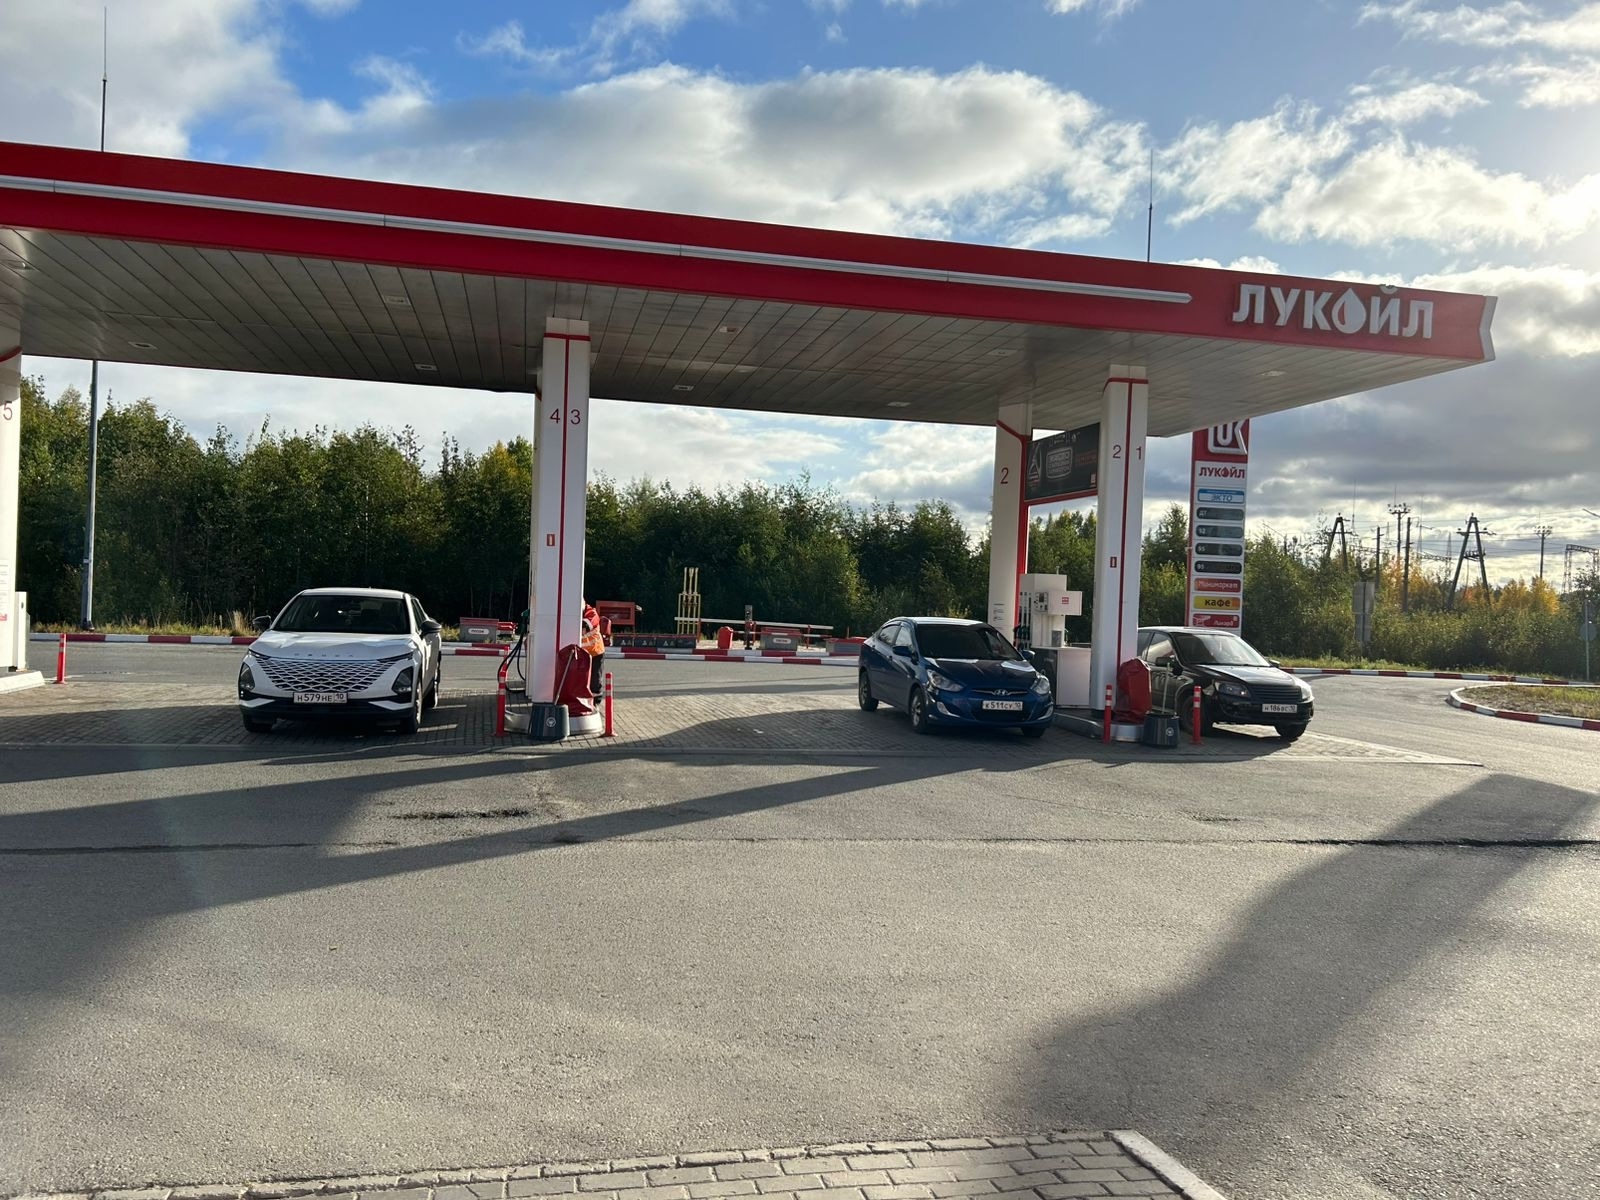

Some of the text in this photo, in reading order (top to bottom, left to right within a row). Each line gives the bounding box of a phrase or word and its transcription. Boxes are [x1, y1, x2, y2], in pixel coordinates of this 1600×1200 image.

[1232, 283, 1435, 339] ЛУКОЙЛ
[2, 400, 13, 421] 5
[549, 408, 561, 424] 4
[570, 408, 581, 425] 3
[1112, 444, 1121, 459] 2
[1135, 446, 1142, 461] 1
[1000, 467, 1010, 484] 2
[1198, 466, 1245, 479] ЛУКОЙЛ
[1205, 599, 1231, 608] кафе
